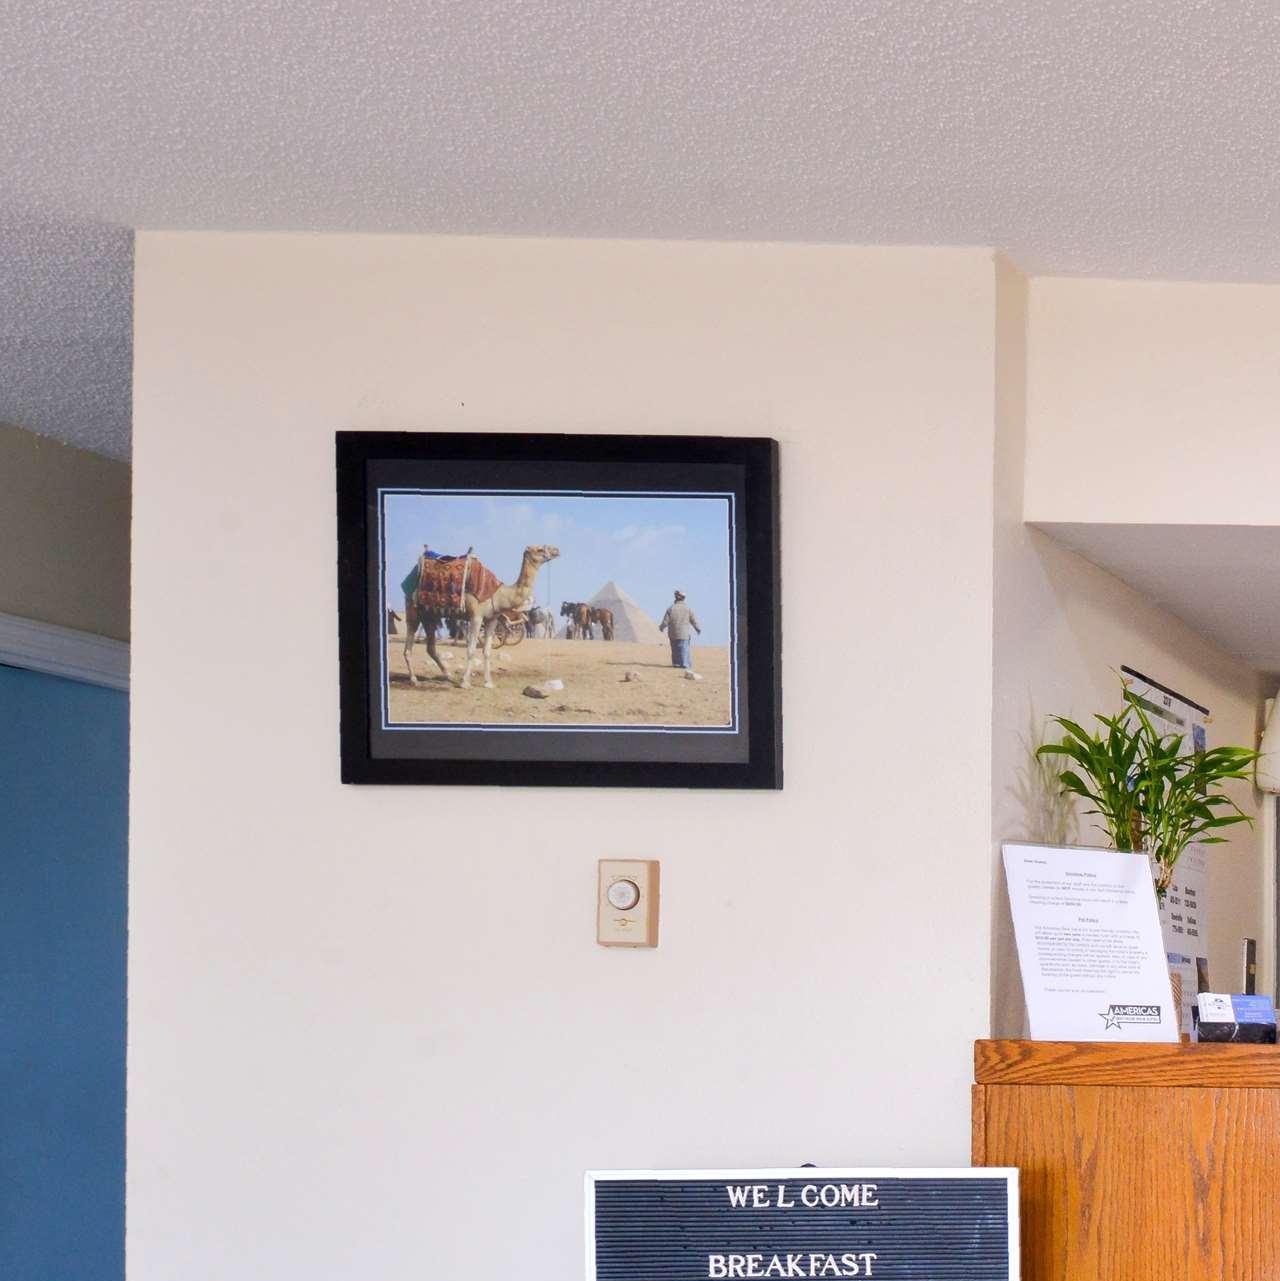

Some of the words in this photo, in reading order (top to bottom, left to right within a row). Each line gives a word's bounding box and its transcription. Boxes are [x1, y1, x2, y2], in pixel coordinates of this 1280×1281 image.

[1114, 1006, 1159, 1016] AMERICAS
[726, 1184, 880, 1208] WELCOME
[708, 1253, 877, 1278] BREAKFAST
